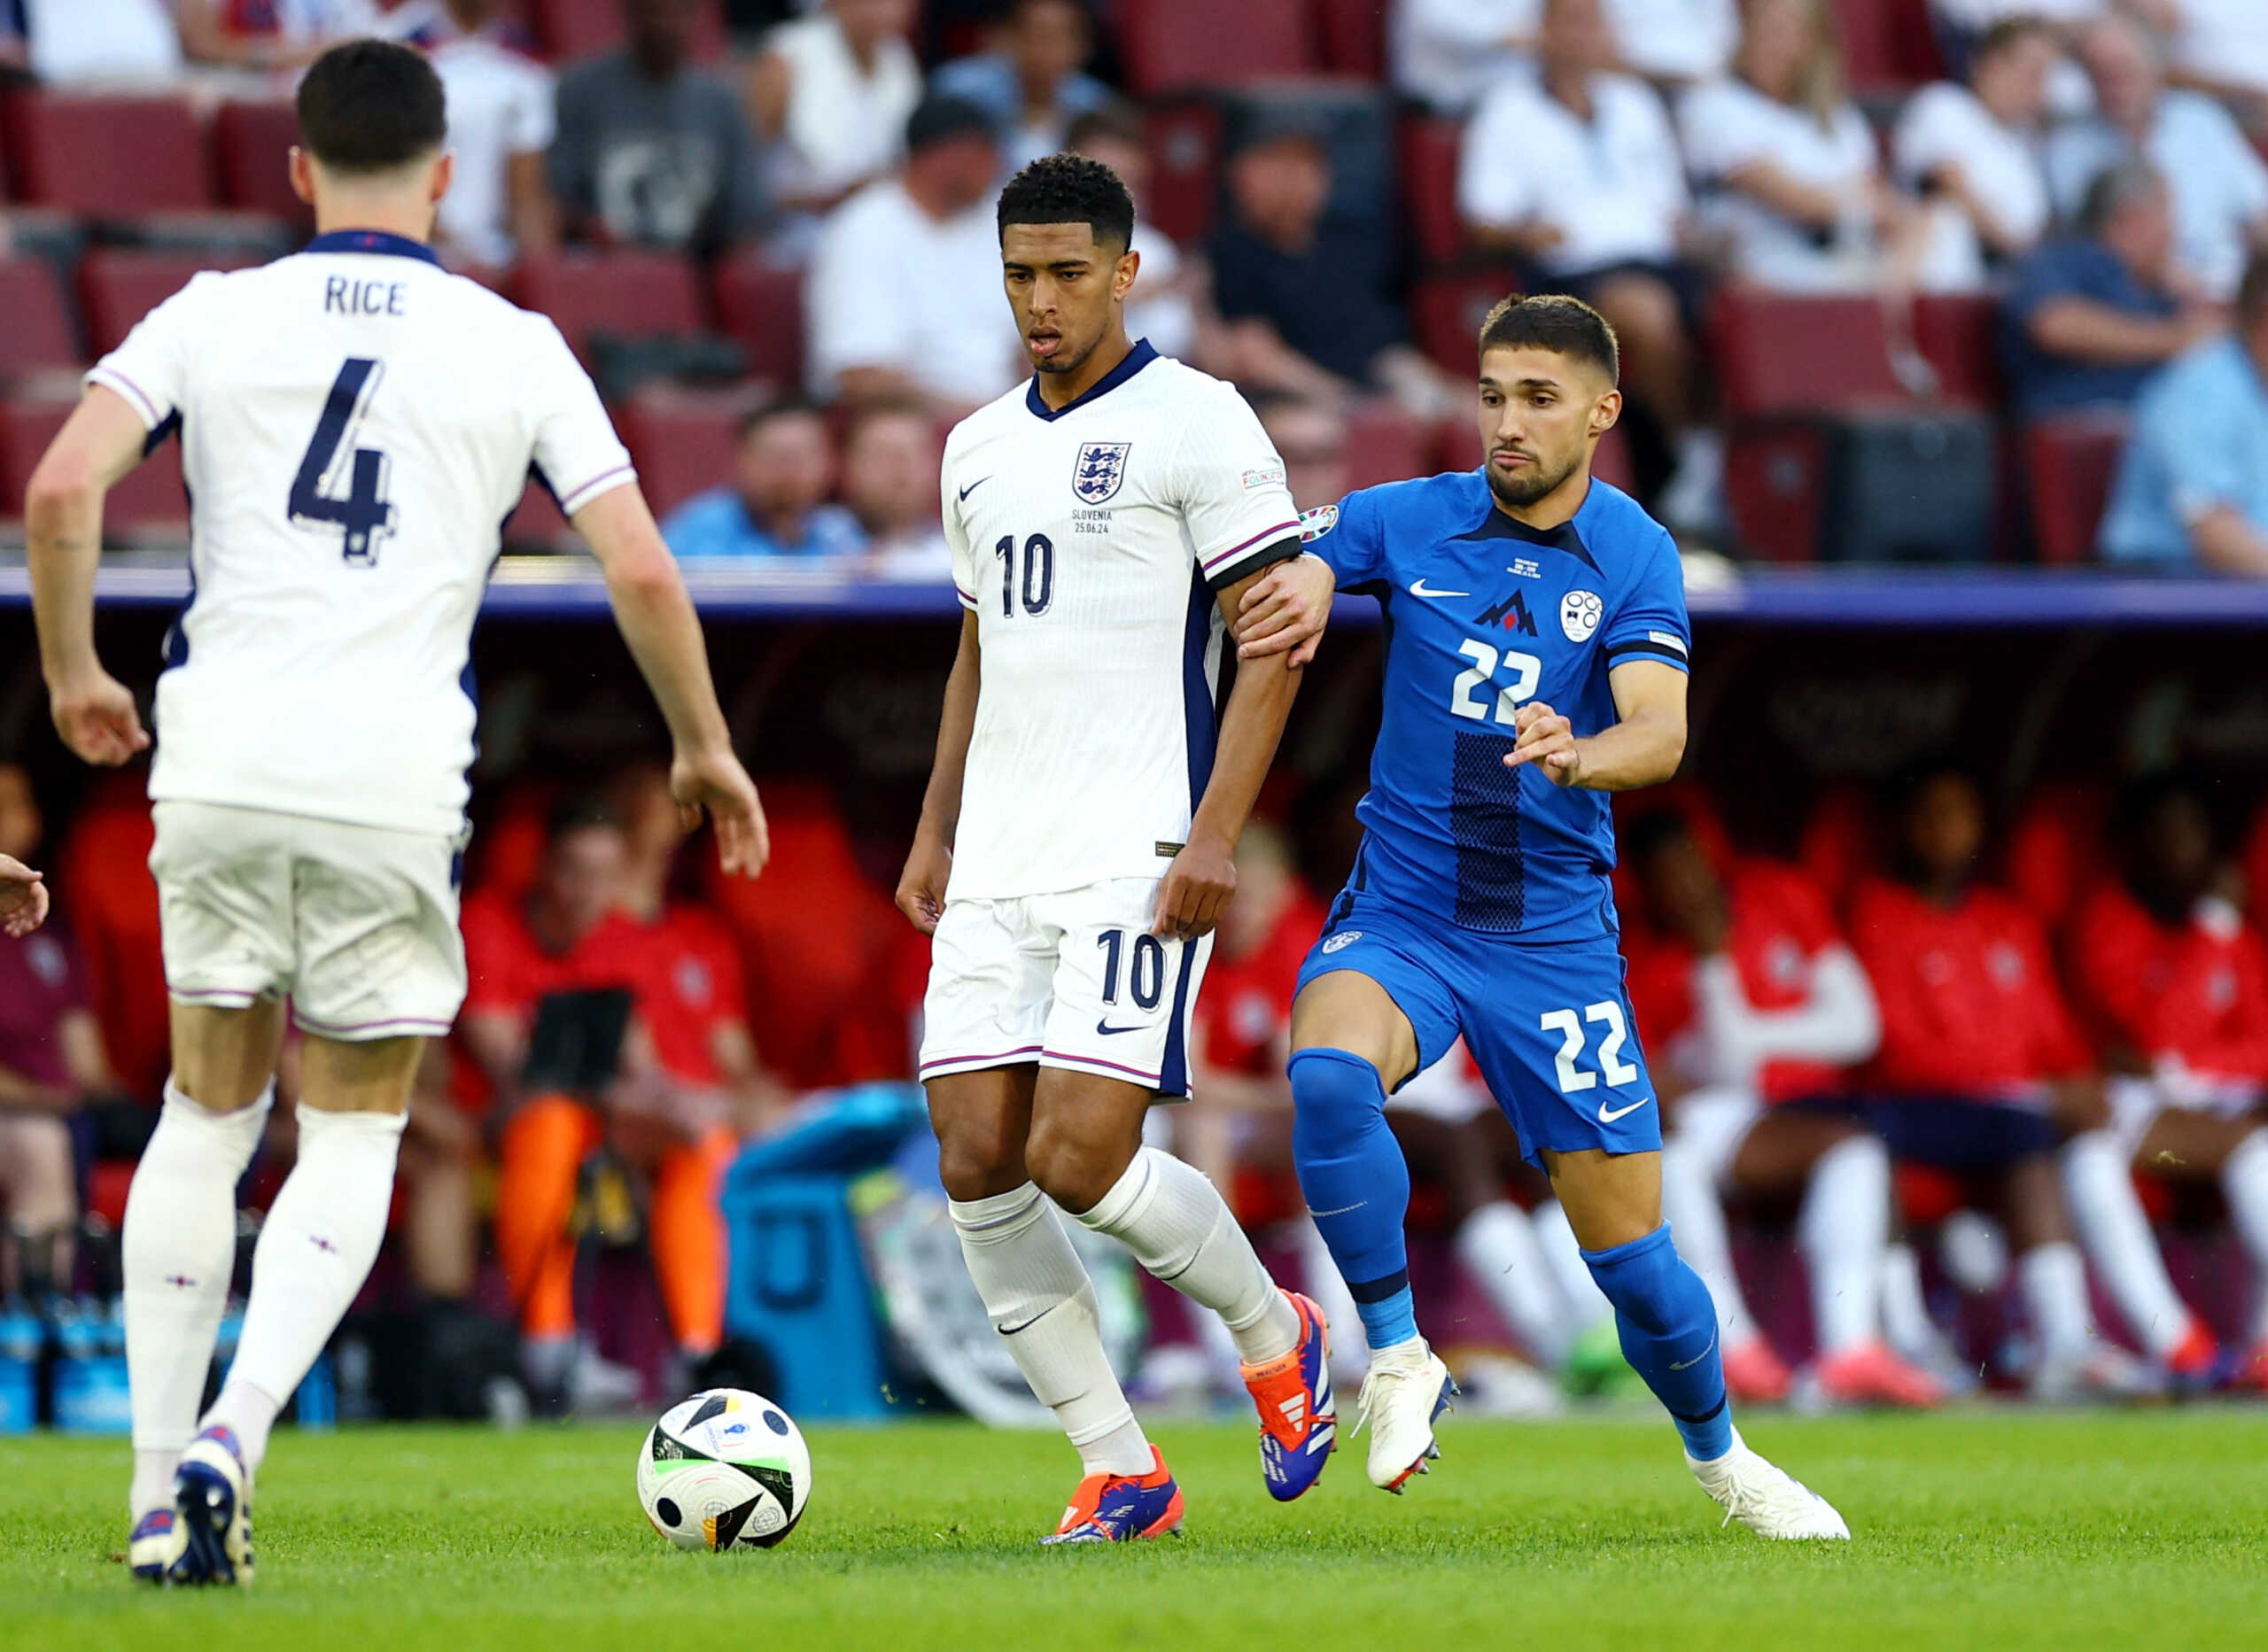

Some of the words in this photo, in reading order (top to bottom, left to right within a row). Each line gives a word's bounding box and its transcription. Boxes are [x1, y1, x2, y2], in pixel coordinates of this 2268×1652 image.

[324, 275, 407, 315] RICE
[288, 358, 399, 568] 4
[1071, 509, 1113, 521] SLOVENIA
[1075, 523, 1109, 534] 25.06.24
[996, 533, 1055, 618] 10
[1450, 638, 1542, 725] 22
[1097, 930, 1167, 1013] 10
[1540, 1000, 1637, 1093] 22
